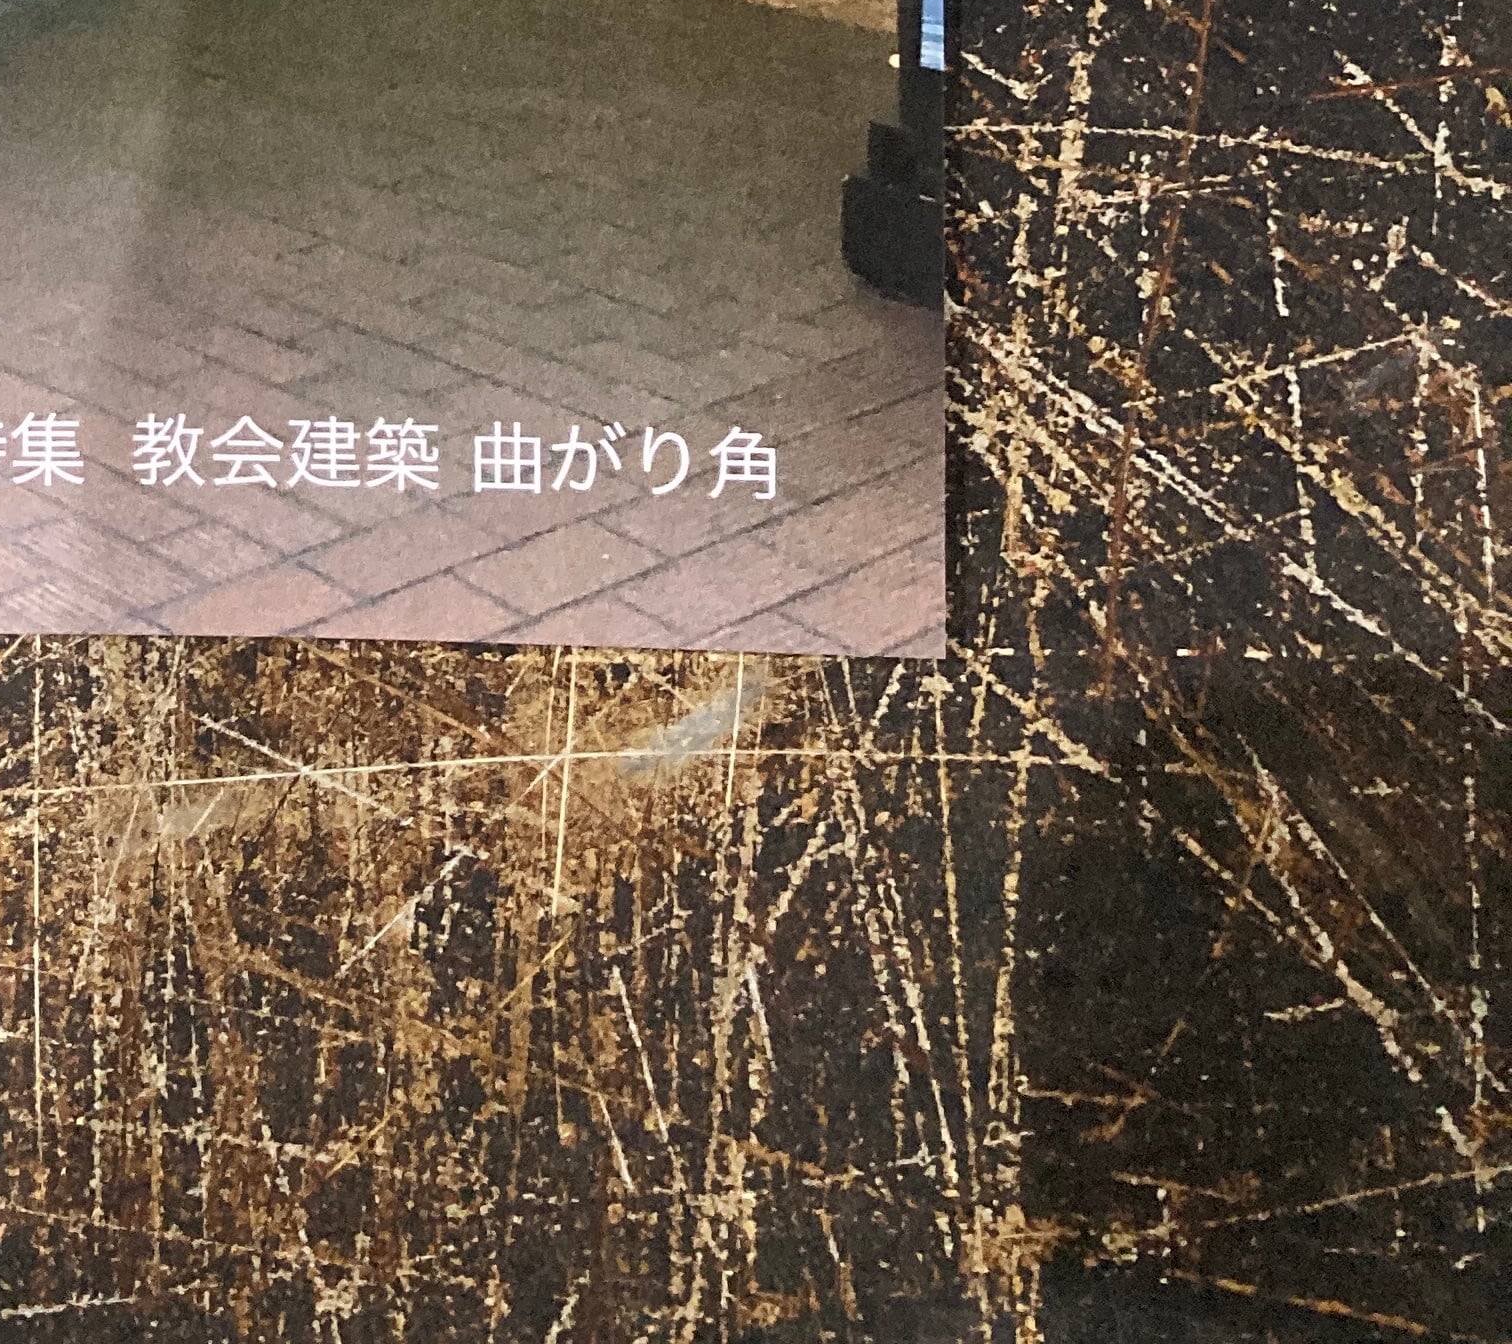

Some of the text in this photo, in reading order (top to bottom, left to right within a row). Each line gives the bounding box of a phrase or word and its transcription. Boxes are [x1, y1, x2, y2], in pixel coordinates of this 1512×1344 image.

[131, 413, 441, 492] 教会建築
[472, 421, 780, 500] 曲がり角
